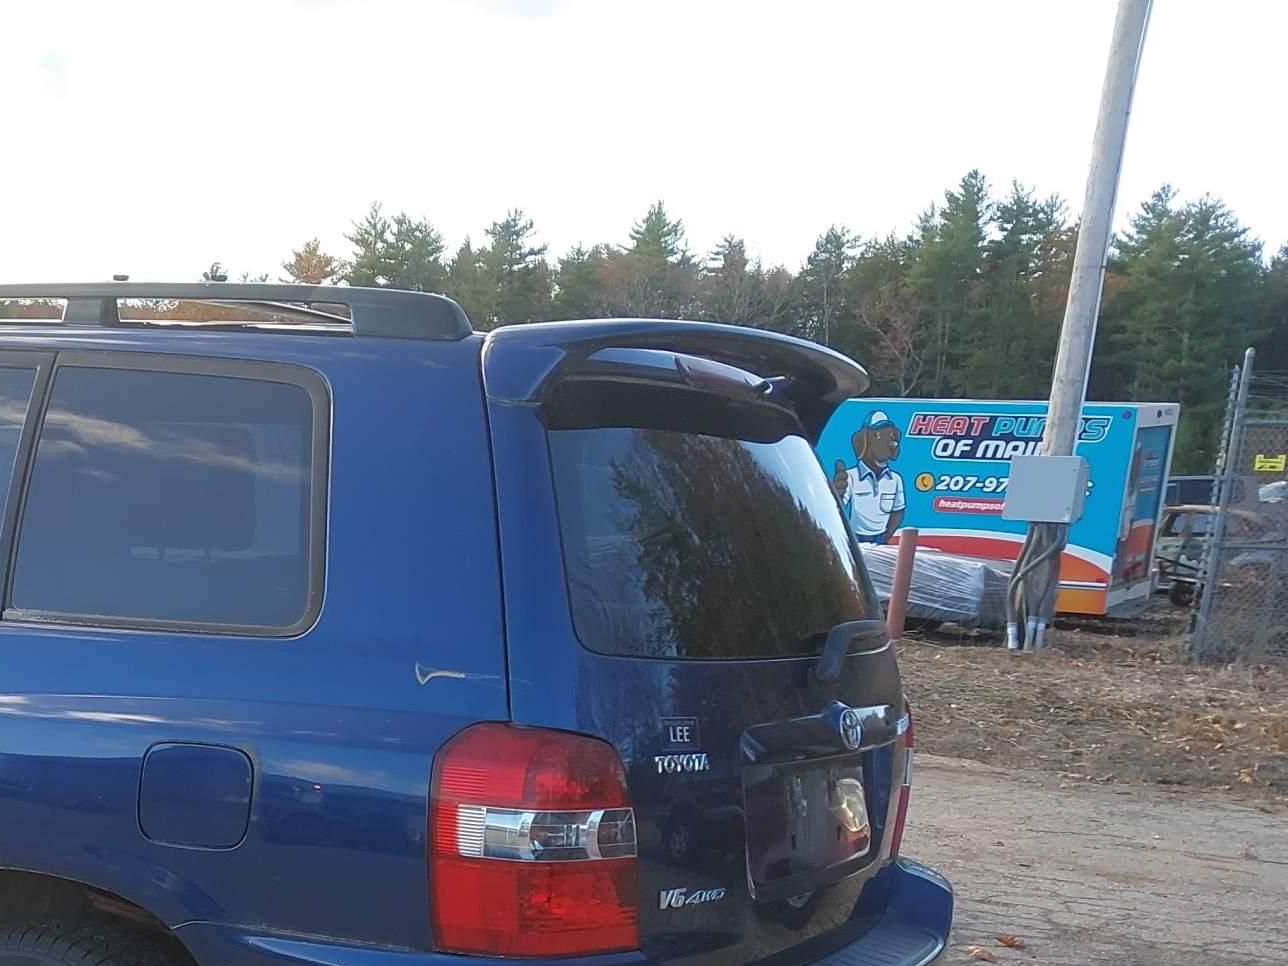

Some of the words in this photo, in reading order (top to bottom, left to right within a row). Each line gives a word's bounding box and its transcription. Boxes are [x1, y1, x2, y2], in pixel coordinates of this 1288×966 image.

[910, 415, 989, 436] HEAT
[992, 416, 1109, 440] PUS
[935, 439, 973, 457] OF
[936, 475, 1009, 493] 207-97
[938, 499, 1006, 511] heatpumpsof
[669, 726, 691, 743] LEE
[655, 753, 711, 774] TOYOTA
[659, 887, 688, 910] V6
